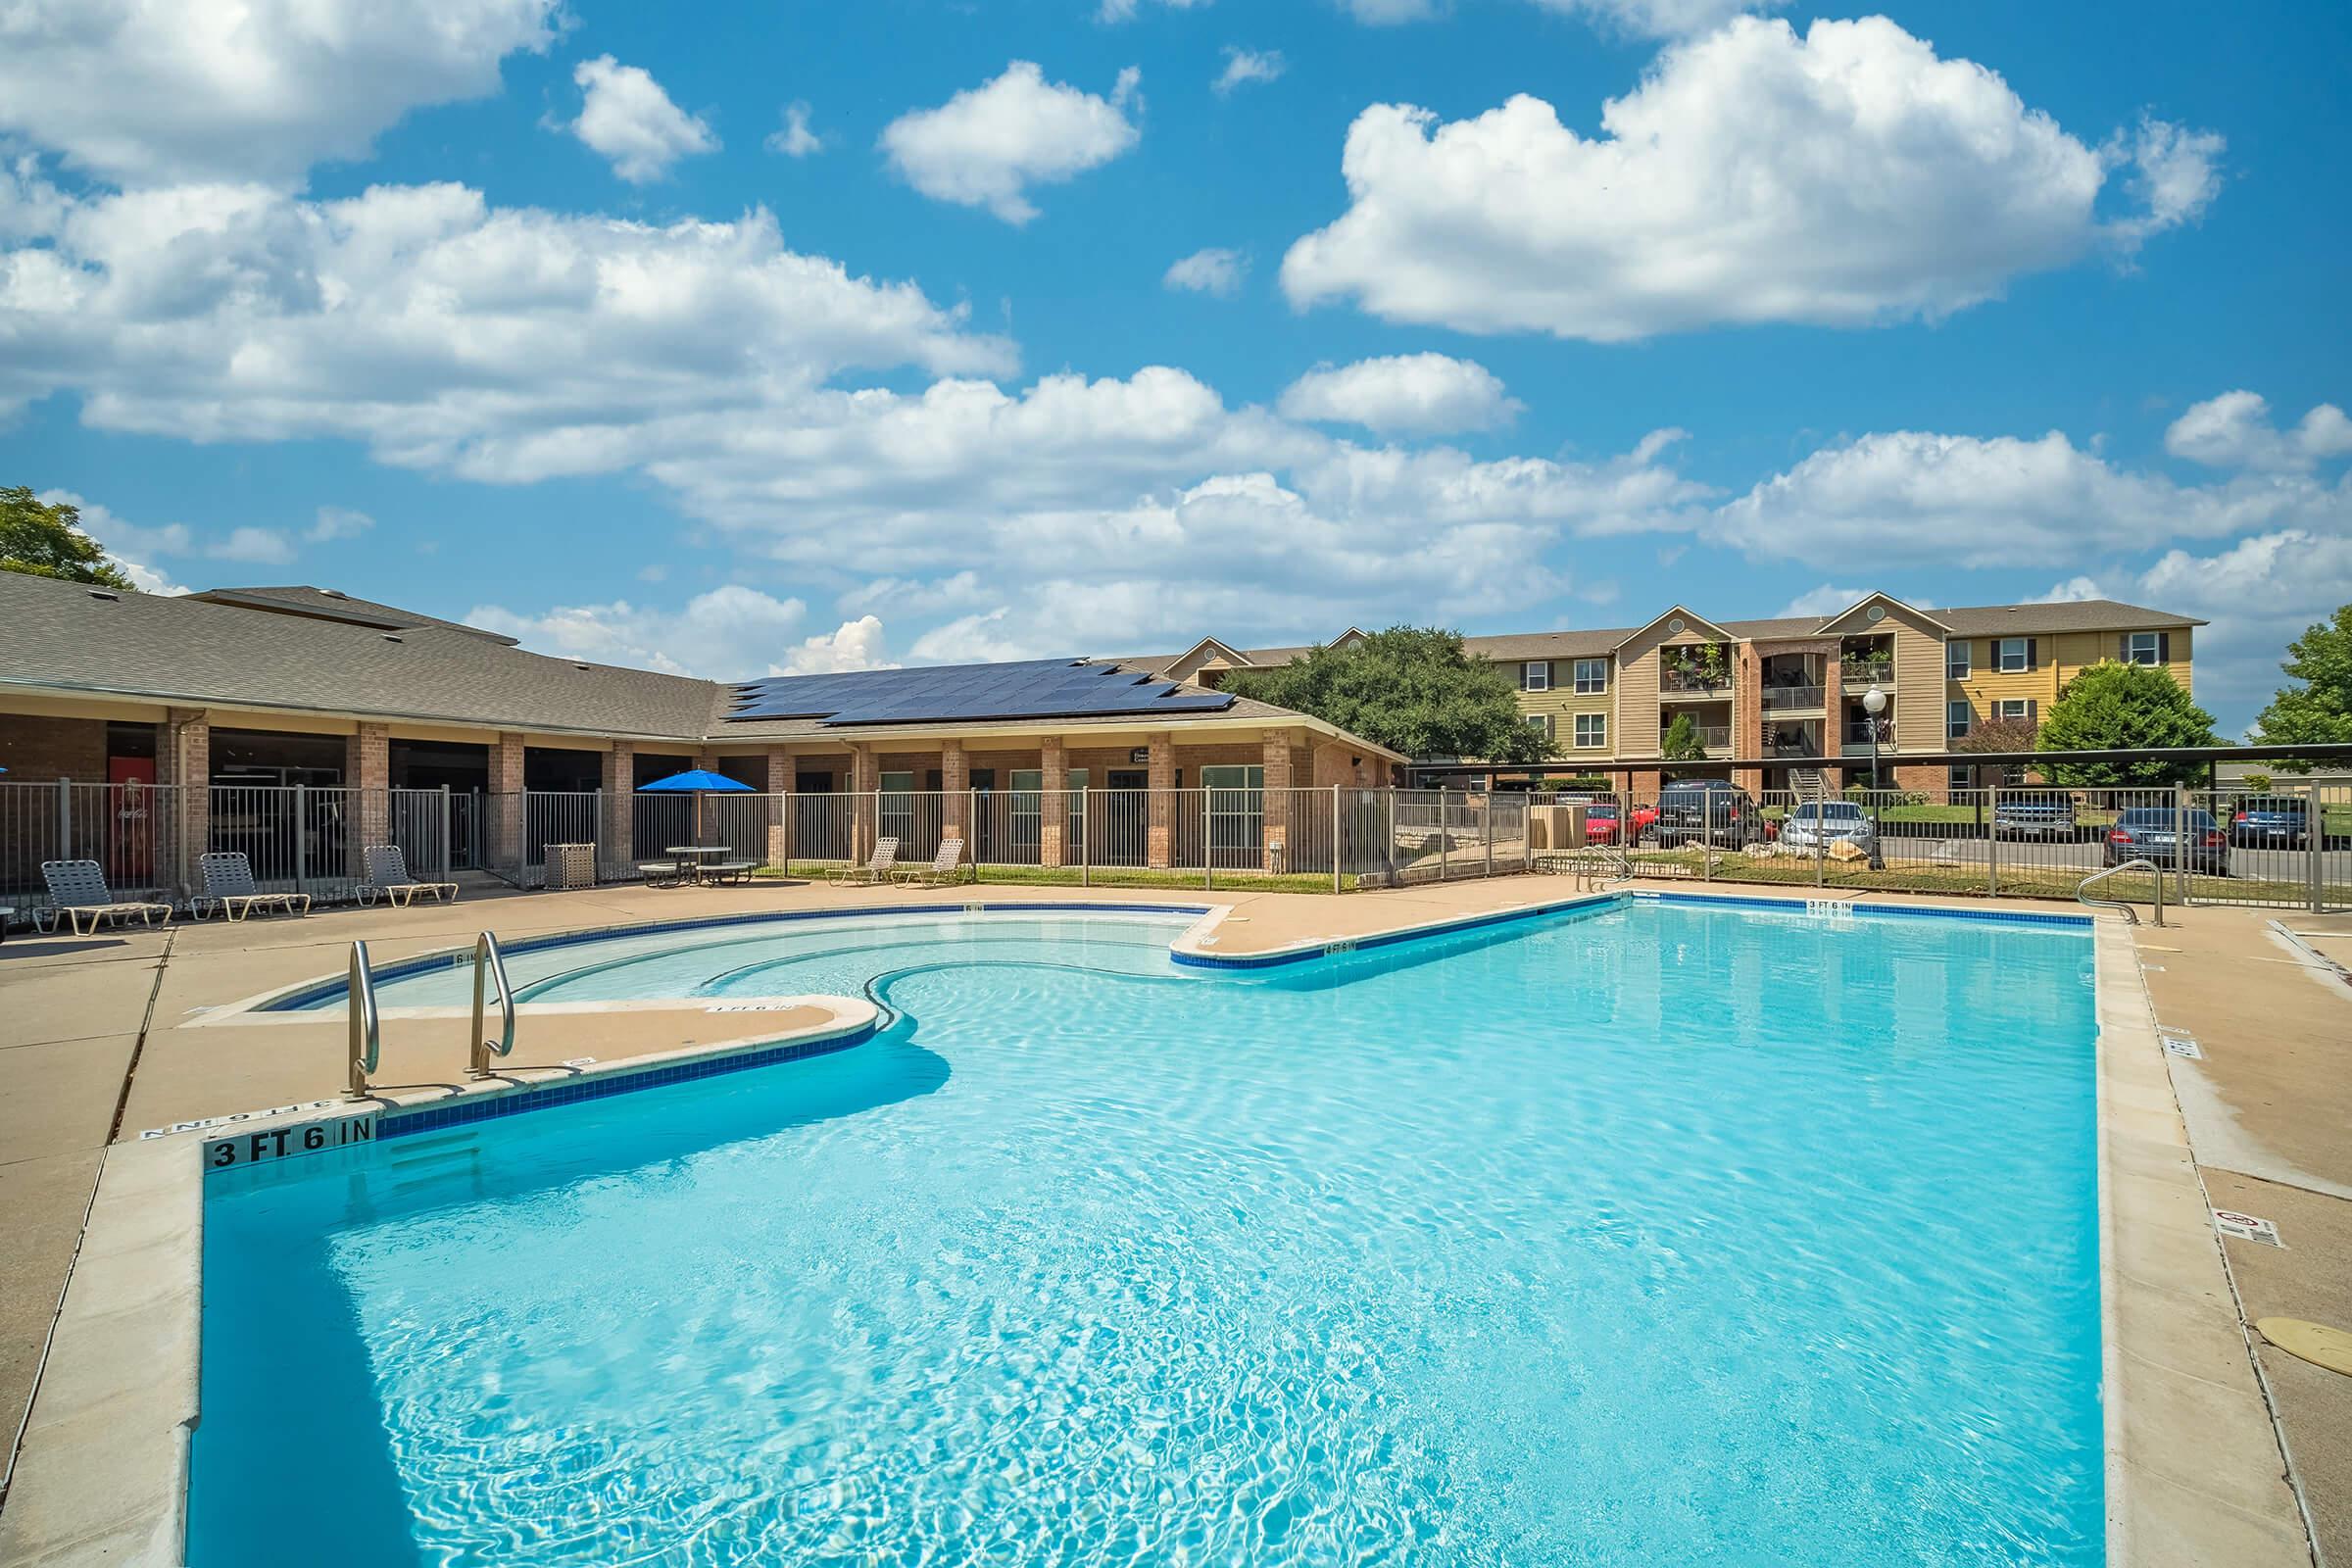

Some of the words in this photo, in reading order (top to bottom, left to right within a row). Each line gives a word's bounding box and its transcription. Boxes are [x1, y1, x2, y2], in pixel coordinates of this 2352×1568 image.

[1818, 901, 1829, 909] FT
[1841, 902, 1851, 910] IN
[456, 954, 464, 964] 6
[214, 1142, 236, 1167] 3
[304, 1126, 324, 1150] 6
[341, 1117, 369, 1146] IN
